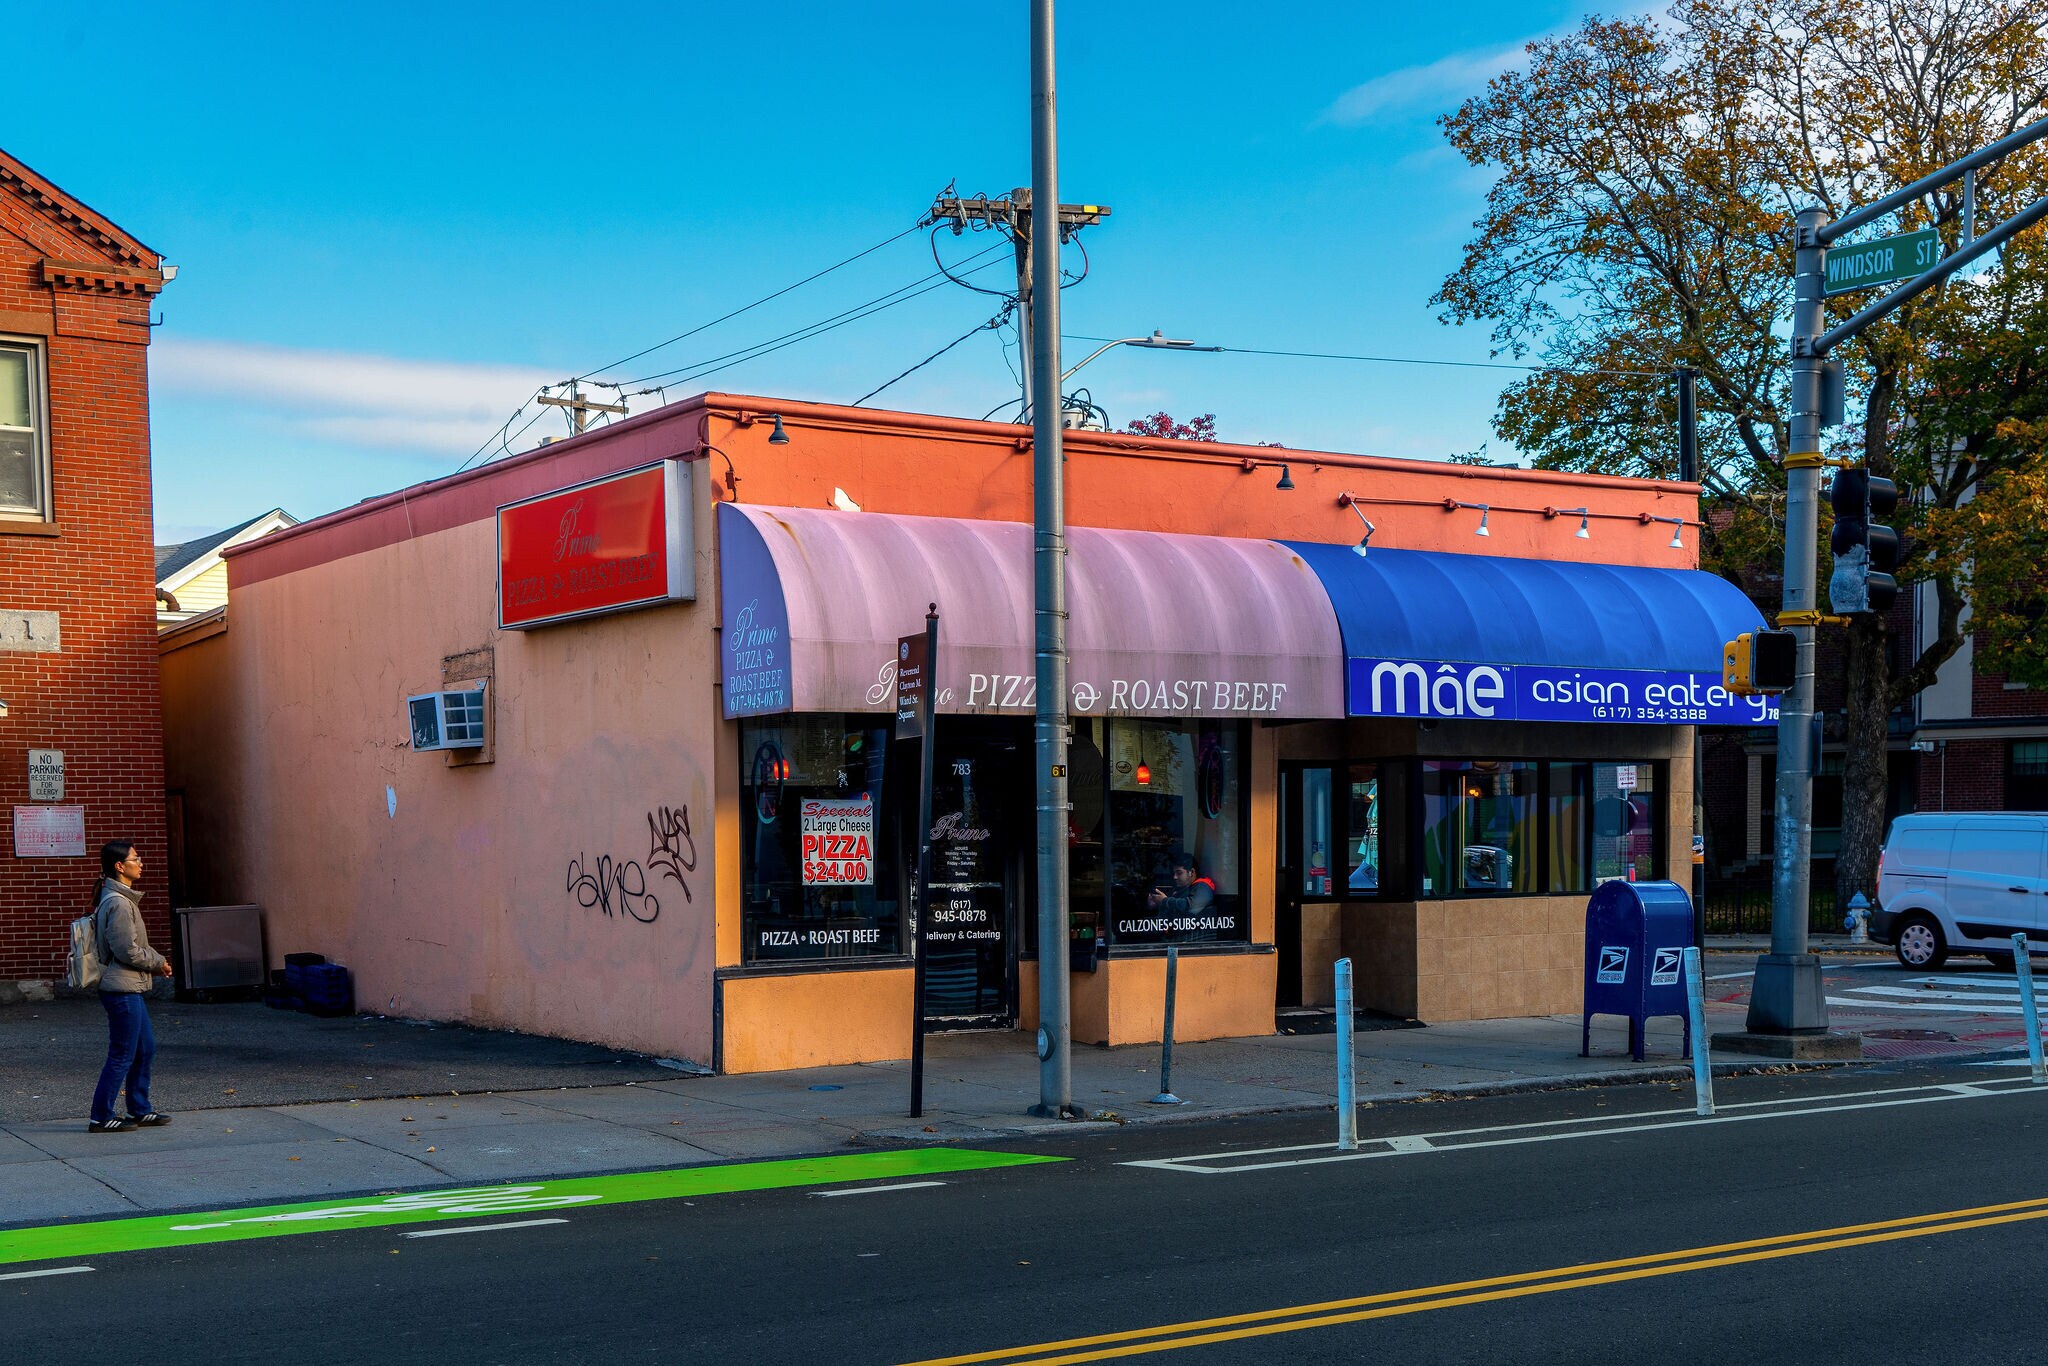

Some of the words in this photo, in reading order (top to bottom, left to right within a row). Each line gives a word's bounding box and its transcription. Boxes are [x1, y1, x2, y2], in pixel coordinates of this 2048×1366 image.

[1828, 248, 1894, 282] WINDSOR
[1916, 239, 1933, 266] ST
[507, 575, 547, 608] PIZZA
[569, 561, 617, 595] ROAST
[619, 552, 659, 585] BEEF
[730, 598, 778, 651] Primo
[736, 650, 762, 670] PIZZA
[766, 648, 774, 666] &
[900, 665, 920, 677] Reverend
[730, 673, 759, 694] ROAST
[760, 669, 783, 689] BEEF
[1532, 673, 1629, 704] asian
[730, 690, 784, 711] 617-945-0878
[966, 673, 1036, 707] PIZZ
[1109, 680, 1208, 710] ROAST
[1212, 682, 1287, 711] BEEF
[898, 709, 915, 722] Square
[1593, 706, 1631, 718] (617)
[1637, 707, 1707, 720] 354-3388
[40, 754, 52, 764] NO
[30, 765, 63, 774] PARKING
[952, 764, 970, 775] 783
[1052, 766, 1065, 776] 61
[36, 788, 58, 796] CLERGY
[802, 802, 872, 819] Special
[804, 818, 809, 831] 2
[812, 818, 837, 834] Large
[839, 818, 871, 832] Cheese
[930, 811, 990, 840] Primo
[802, 834, 872, 860] PIZZA
[803, 861, 867, 884] $24.00
[950, 899, 971, 910] (617)
[934, 909, 987, 922] 945-0878
[761, 931, 799, 946] PIZZA
[809, 929, 851, 945] ROAST
[852, 929, 880, 944] BEEF
[926, 931, 956, 941] elivery
[957, 930, 965, 939] &
[966, 929, 1001, 941] Catering
